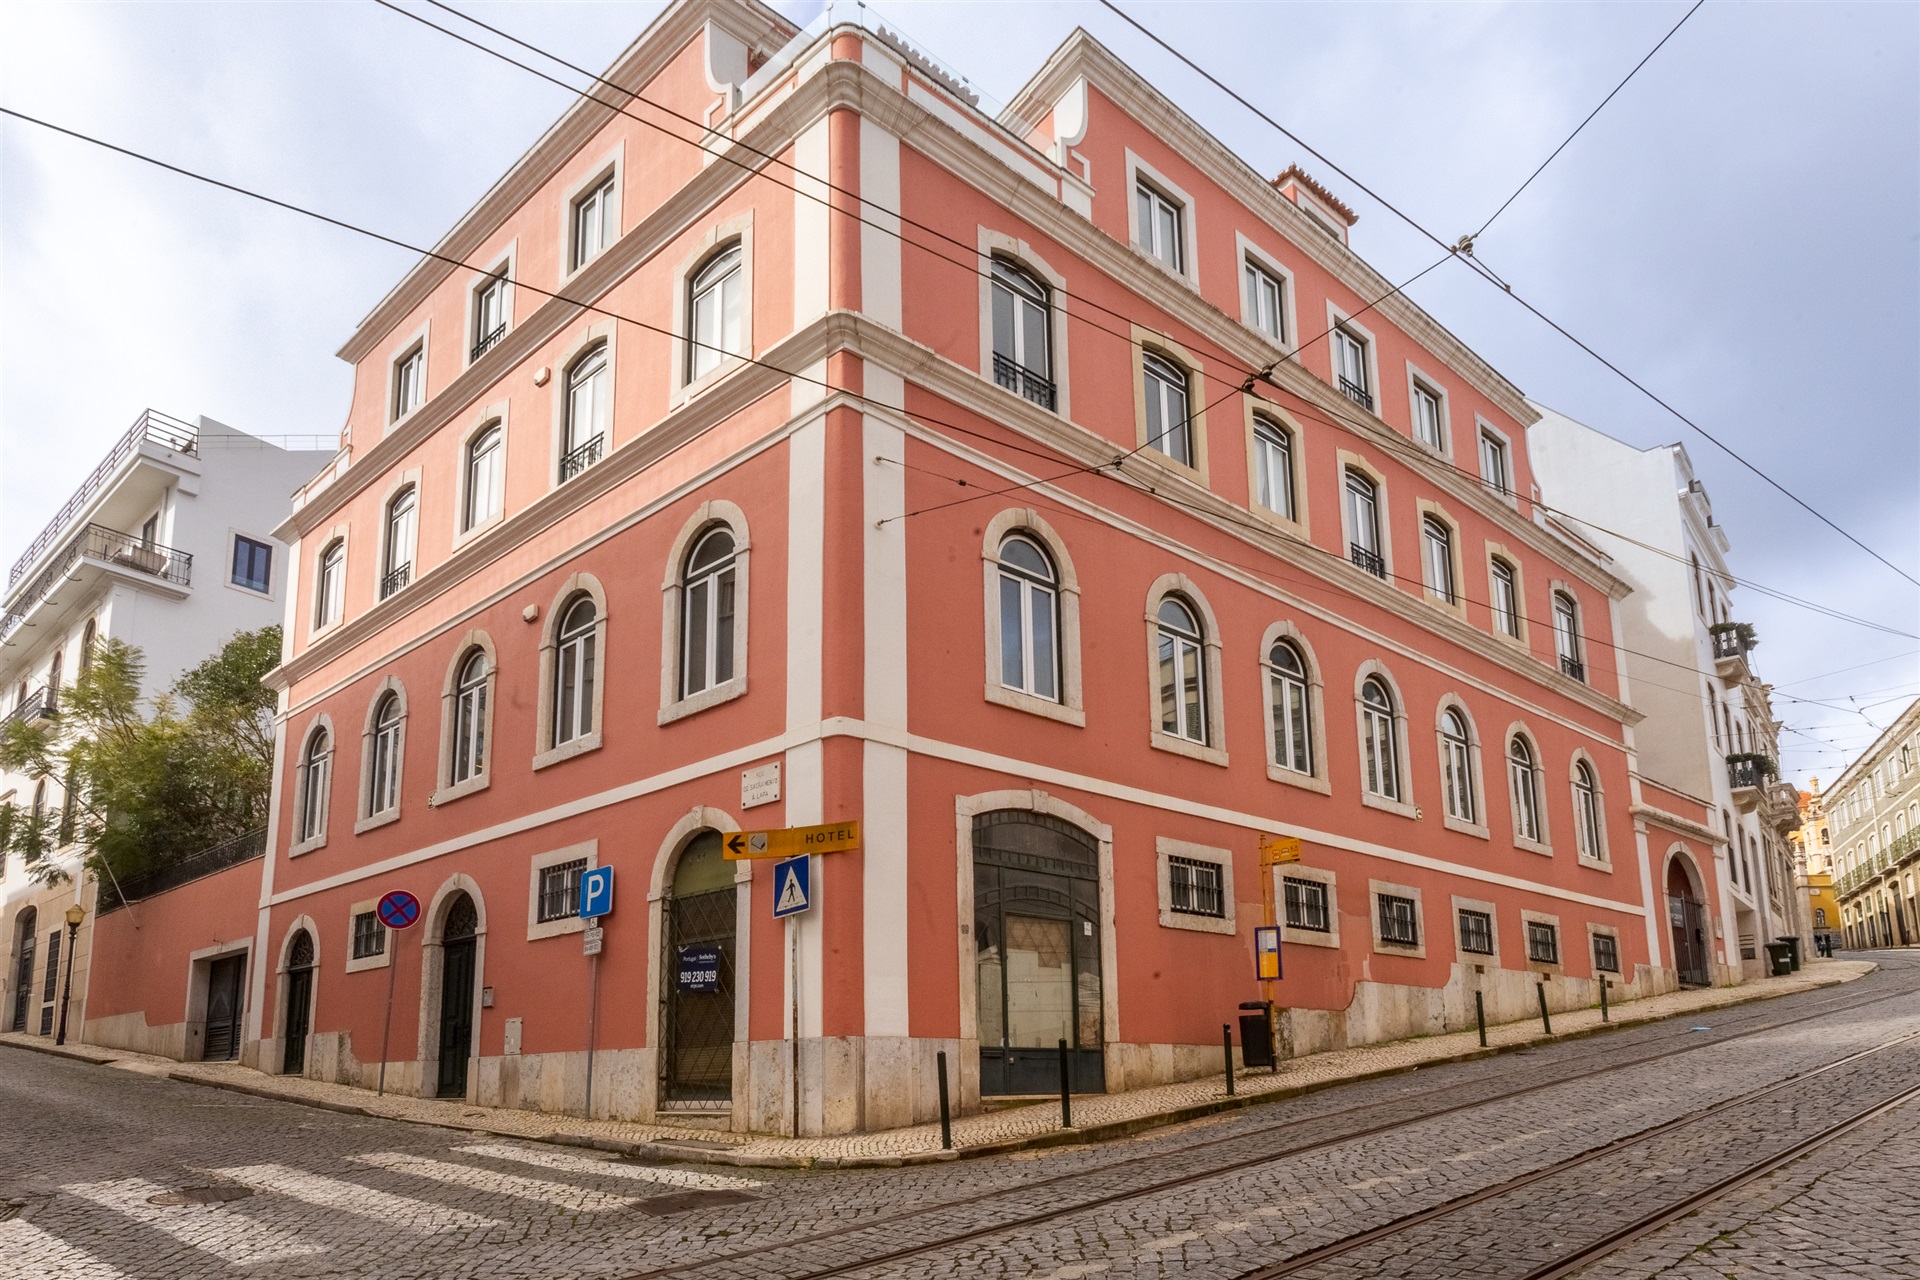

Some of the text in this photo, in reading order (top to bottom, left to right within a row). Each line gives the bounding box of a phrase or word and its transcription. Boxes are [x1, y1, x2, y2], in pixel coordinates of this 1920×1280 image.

[805, 829, 854, 844] HOTEL
[586, 874, 604, 912] P
[680, 970, 716, 983] 919 230 919
